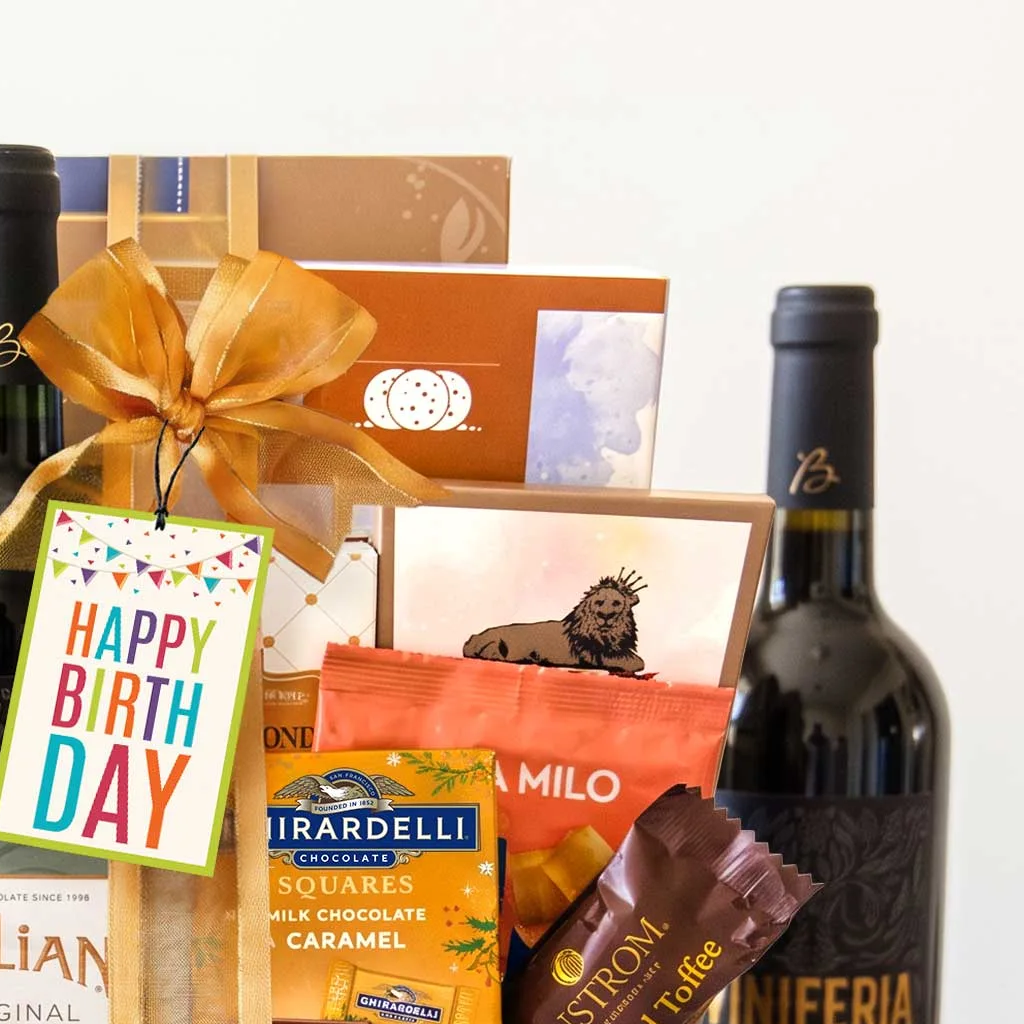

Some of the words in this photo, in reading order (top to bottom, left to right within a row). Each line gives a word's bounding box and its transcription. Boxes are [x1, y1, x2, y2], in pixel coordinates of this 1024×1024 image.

[65, 600, 217, 674] HAPPY
[51, 662, 203, 748] BIRTH
[263, 726, 314, 749] OND
[32, 733, 191, 849] DAY
[518, 762, 621, 803] MILO
[314, 803, 348, 812] FOUNDED
[268, 816, 465, 840] IRARDELLI
[300, 854, 388, 863] CHOCOLATE
[32, 893, 62, 901] SINCE
[278, 875, 413, 899] SQUARES
[269, 909, 310, 922] MILK
[317, 908, 426, 921] CHOCOLATE
[286, 931, 406, 950] CARAMEL
[654, 940, 722, 1014] Toffee
